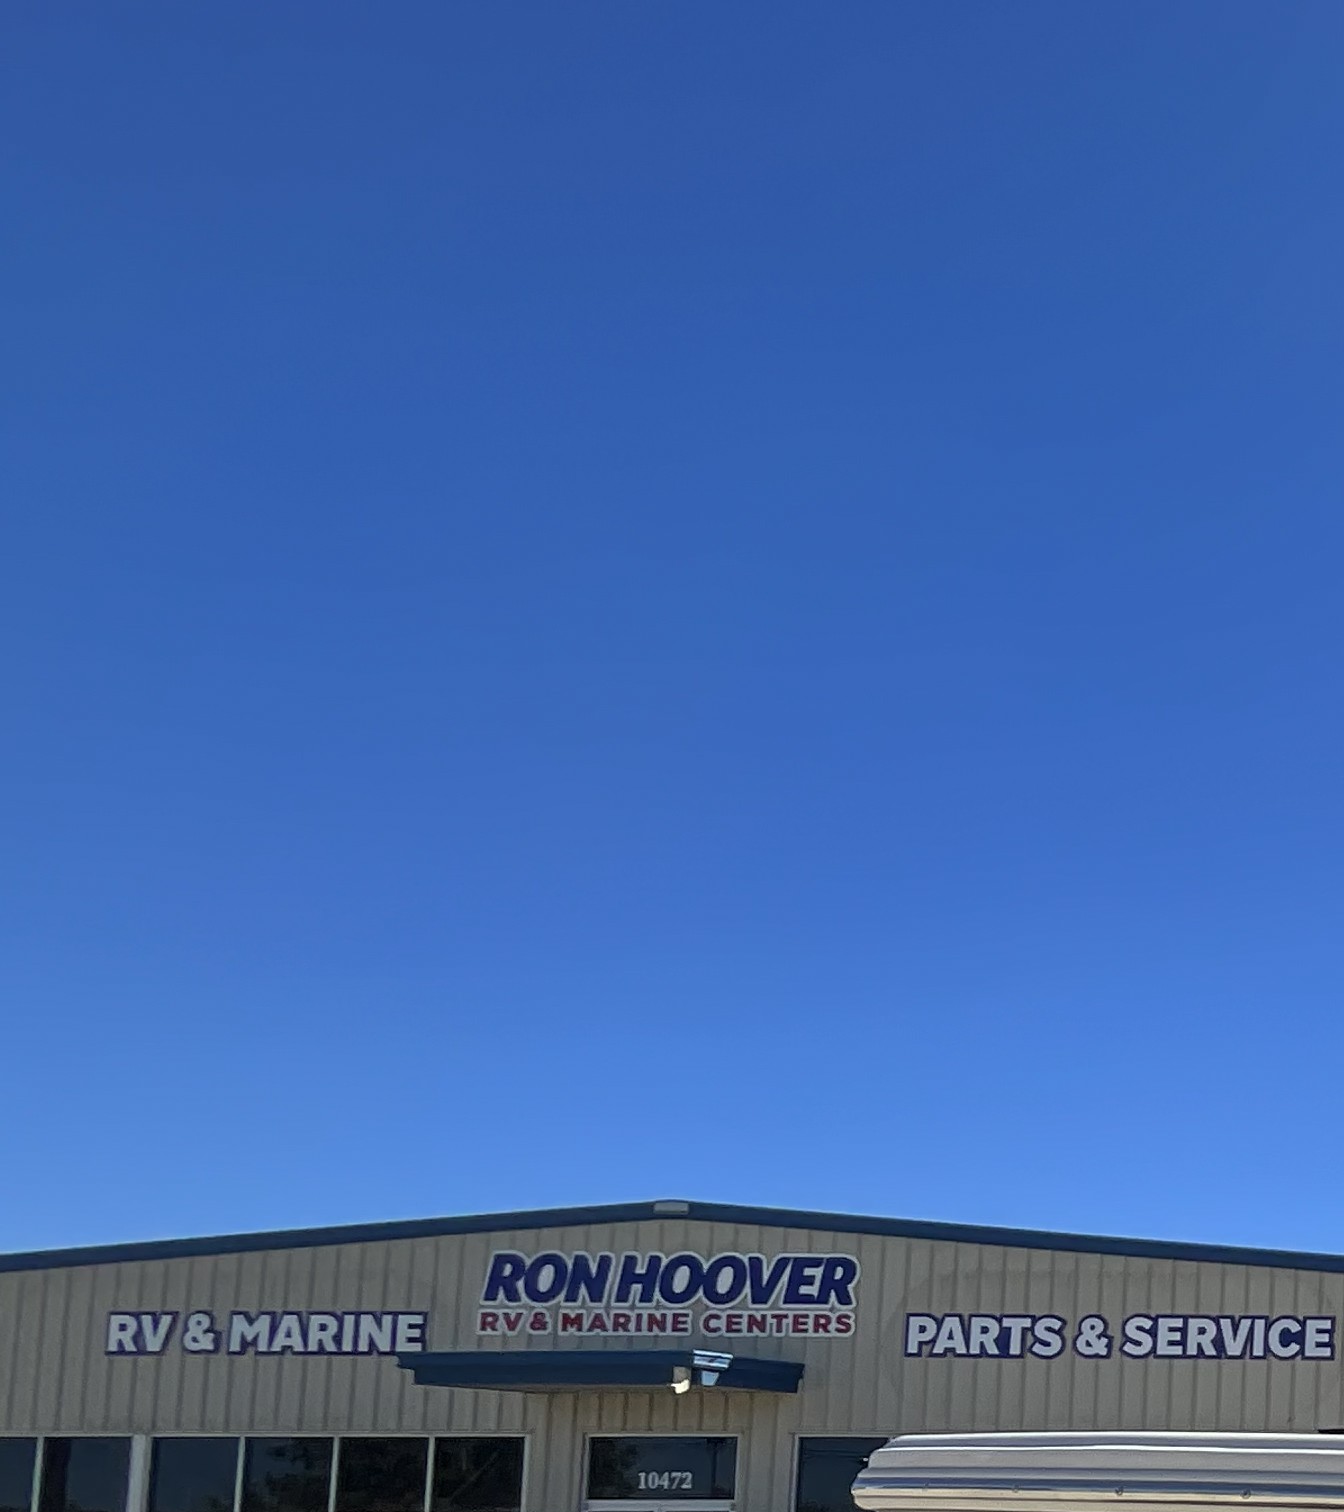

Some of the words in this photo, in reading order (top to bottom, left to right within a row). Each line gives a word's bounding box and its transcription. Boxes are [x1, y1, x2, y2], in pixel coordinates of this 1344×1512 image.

[483, 1253, 613, 1304] RON
[613, 1254, 858, 1306] HOOVER
[106, 1312, 174, 1353] RV
[183, 1312, 217, 1352] &
[228, 1312, 426, 1353] MARINE
[479, 1311, 527, 1332] RV
[529, 1311, 549, 1332] &
[560, 1311, 690, 1333] MARINE
[702, 1312, 854, 1335] CENTERS
[905, 1315, 1063, 1358] PARTS
[1075, 1316, 1109, 1358] &
[1121, 1316, 1333, 1359] SERVICE
[638, 1471, 693, 1490] 10472
